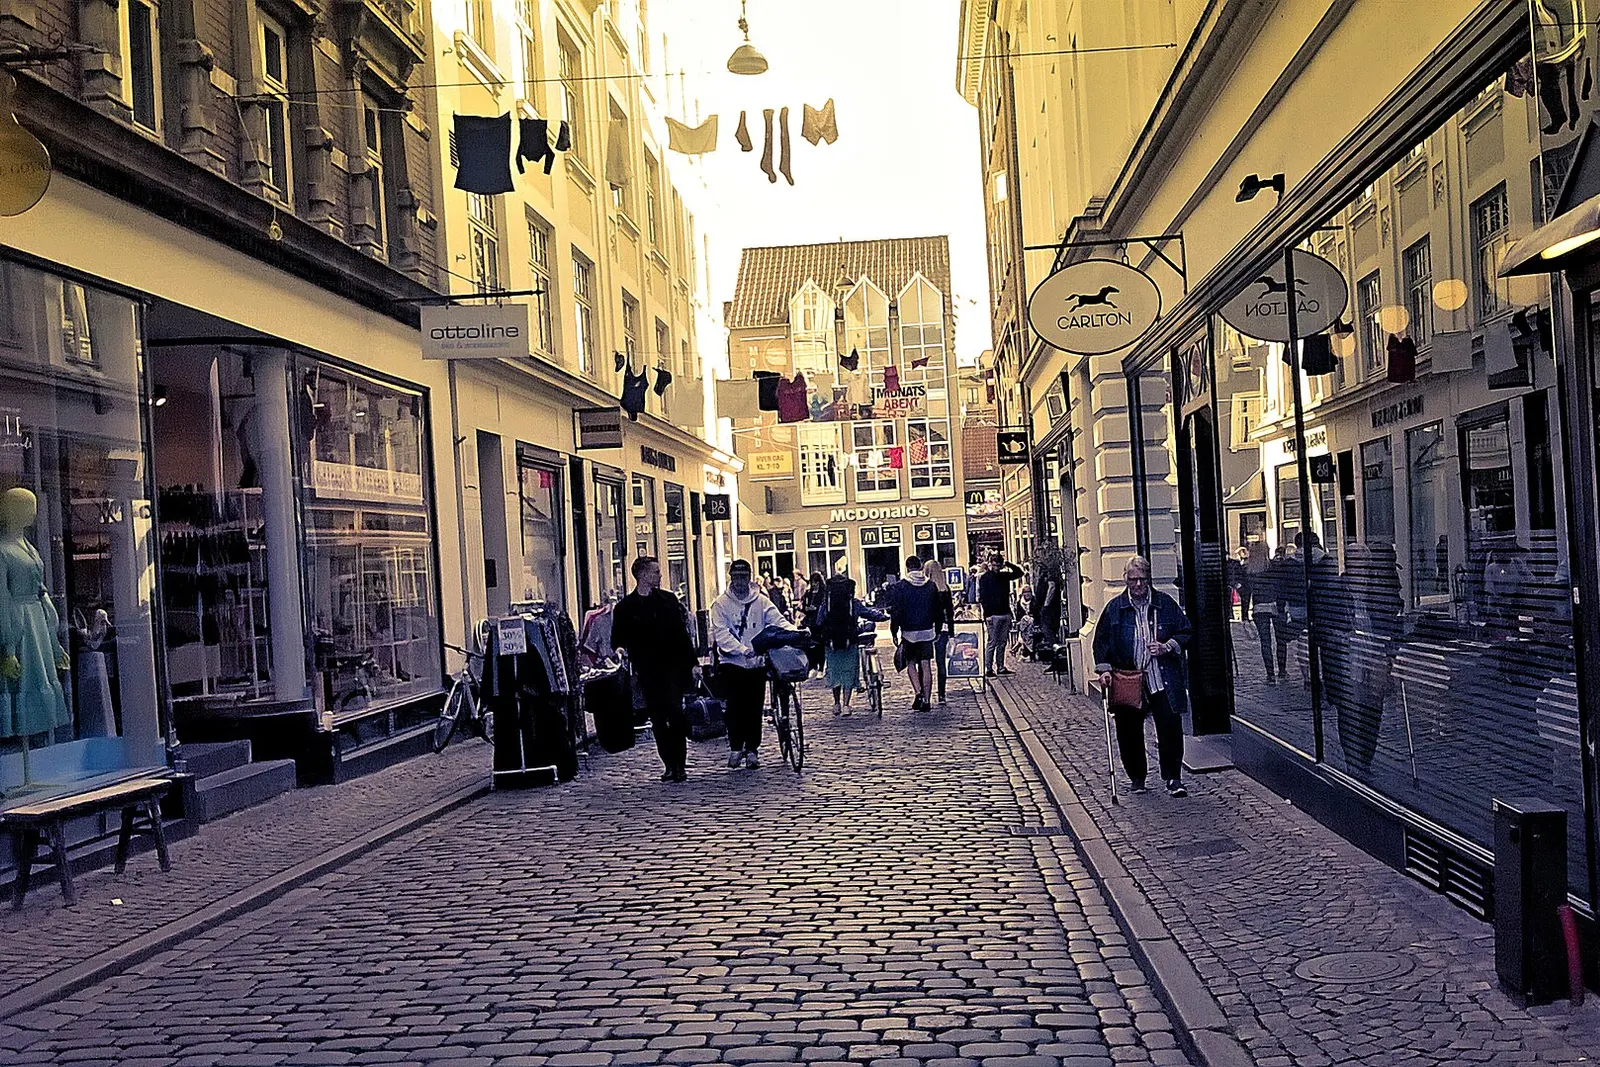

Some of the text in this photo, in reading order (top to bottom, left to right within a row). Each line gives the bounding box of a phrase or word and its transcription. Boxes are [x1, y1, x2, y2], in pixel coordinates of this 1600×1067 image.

[1057, 312, 1132, 330] CARLTON
[430, 323, 519, 340] ottoline
[830, 504, 930, 522] McDonald's
